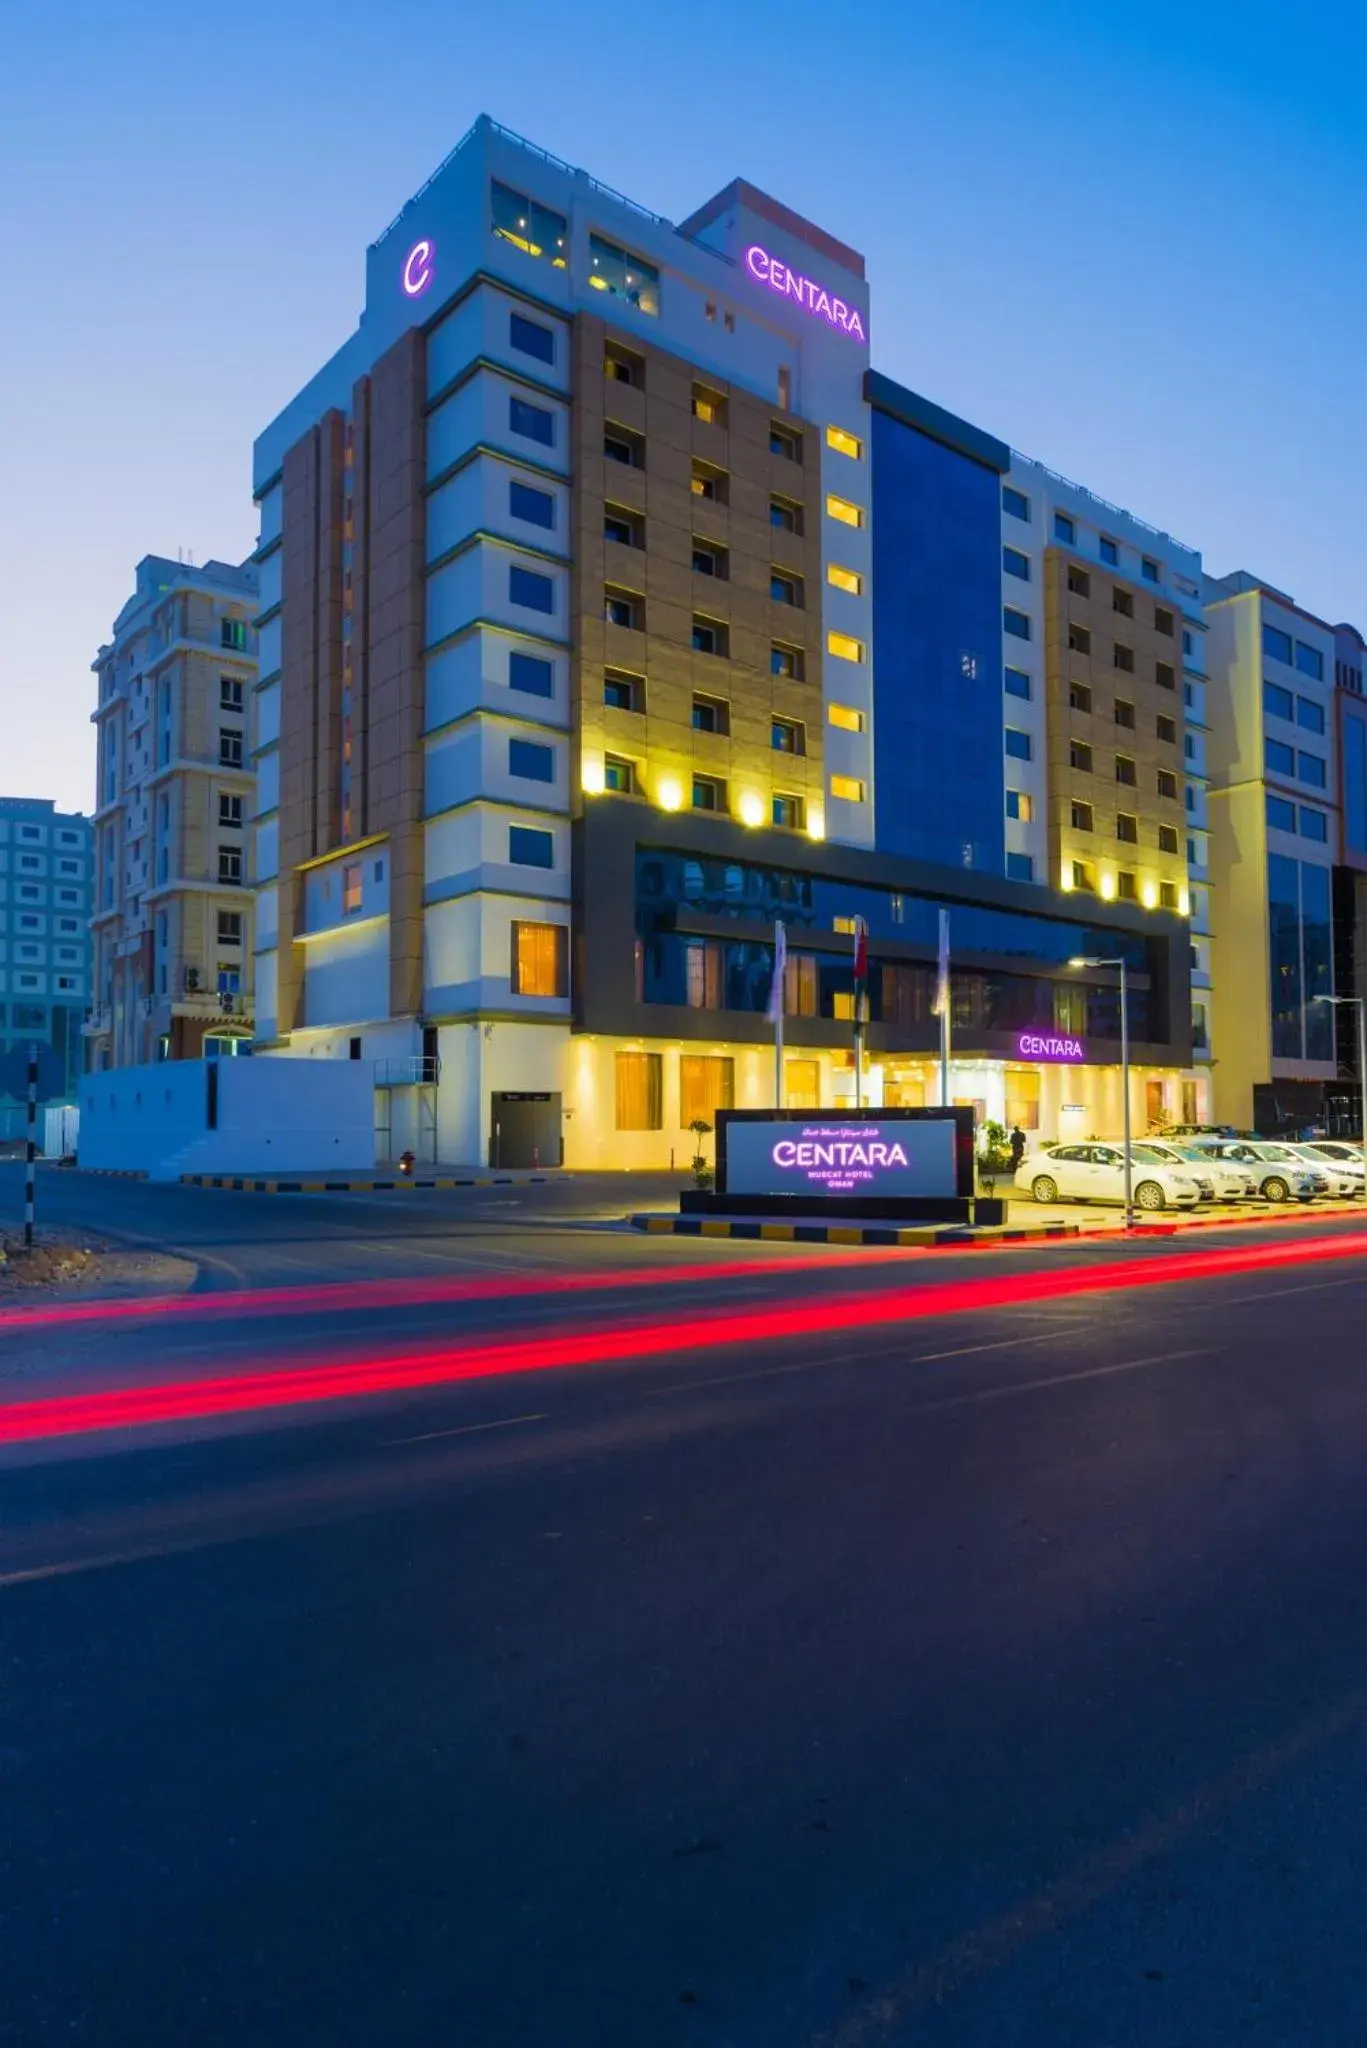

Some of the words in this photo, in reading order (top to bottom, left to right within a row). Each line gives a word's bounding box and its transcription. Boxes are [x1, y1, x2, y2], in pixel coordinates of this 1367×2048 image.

[747, 246, 865, 341] CENTARA
[1019, 1035, 1083, 1057] CENTARA
[772, 1140, 908, 1167] CENTARA
